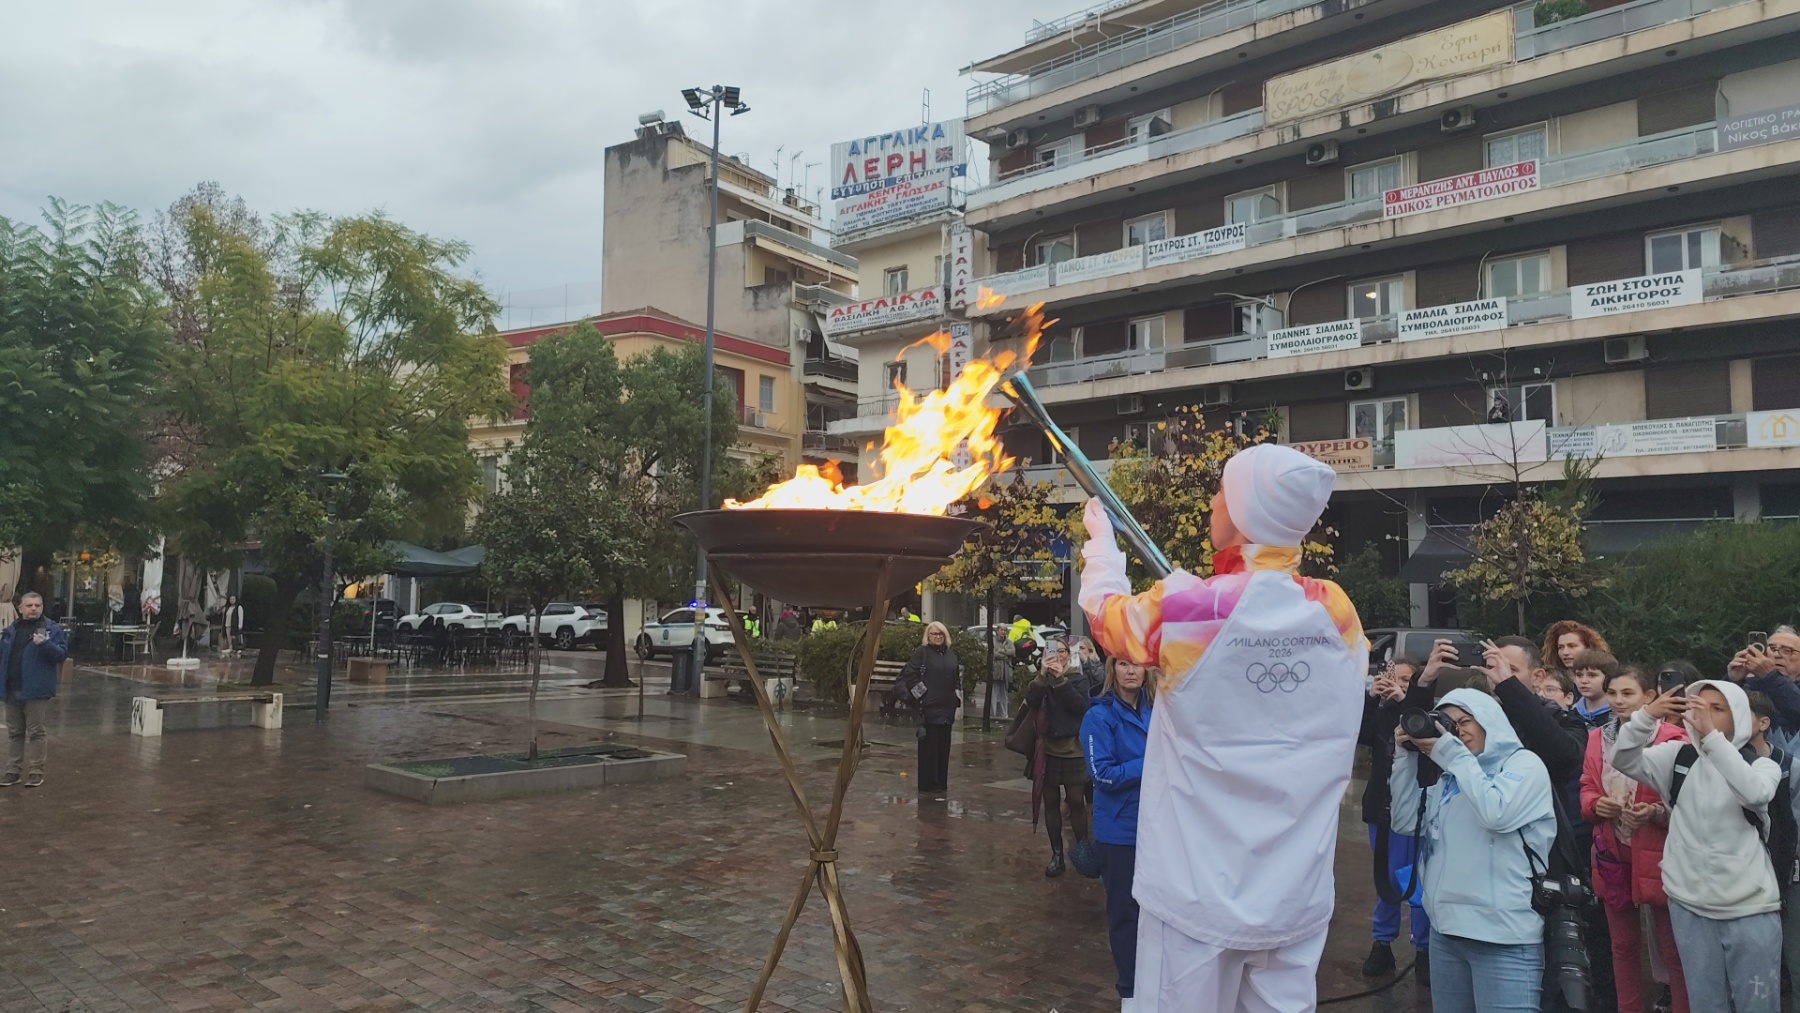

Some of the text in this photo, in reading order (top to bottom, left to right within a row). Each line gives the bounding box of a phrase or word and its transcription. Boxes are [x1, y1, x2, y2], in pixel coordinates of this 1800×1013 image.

[1271, 84, 1345, 119] SPOSA
[1723, 113, 1777, 133] ΛΟΓΙΣΤΙΚΟ
[848, 123, 945, 157] ΑΓΓΛΙΚΑ
[842, 149, 927, 185] ΛΕΡΗ
[868, 182, 912, 200] ΚΕΝΤΡΟ
[1400, 165, 1519, 201] ΜΕΡΑΝΤΖΗΣ ΑΝΤ. ΠΑΥΛΟΣ
[839, 180, 945, 216] ΑΓΓΛΙΚΗΣ ΓΛΩΣΣΑΣ
[1385, 176, 1537, 218] ΕΙΔΙΚΟΣ ΡΕΥΜΑΤΟΛΟΓΟΣ
[1148, 239, 1185, 256] ΣΤΑΥΡΟΣ
[1203, 225, 1244, 244] ΤΖΟΥΡΟΣ
[1059, 261, 1085, 274] ΠΑΝΟΣ
[1586, 274, 1684, 296] ΖΩΗ ΣΤΟΥΠΑ
[831, 290, 936, 317] ΑΓΓΛΙΚΑ
[1590, 286, 1682, 307] ΔΙΚΗΓΟΡΟΣ
[834, 309, 880, 324] ΒΑΣΙΛΙΚΗ
[912, 298, 940, 310] ΛΕΡΗ
[1405, 300, 1498, 321] ΑΜΑΛΙΑ ΣΙΑΛΜΑ
[1272, 321, 1354, 341] ΙΩΑΝΝΗΣ ΣΙΑΛΜΑΣ
[1401, 311, 1505, 333] ΣΥΜΒΟΛΑΙΟΓΡΑΦΟΣ
[1269, 332, 1359, 351] ΣΥΜΒΟΛΑΙΟΓΡΑΦΟΣ
[1676, 420, 1714, 428] ΠΑΝΑΓΙΩΤΗΣ
[1291, 440, 1369, 454] ΟΥΡΕΙΟ
[1226, 636, 1330, 648] MILANO CORTINA
[1268, 649, 1292, 658] 2026
